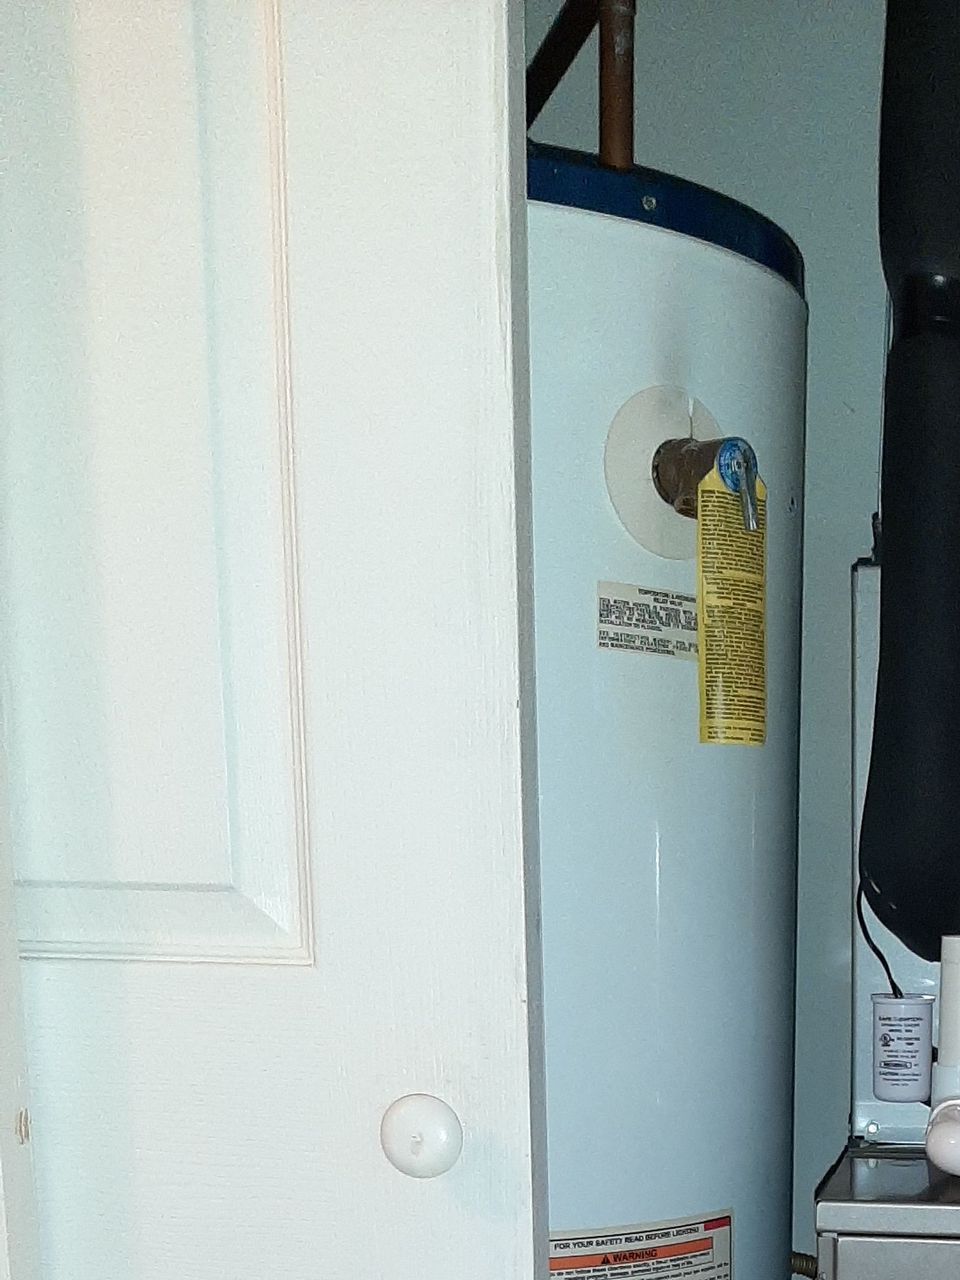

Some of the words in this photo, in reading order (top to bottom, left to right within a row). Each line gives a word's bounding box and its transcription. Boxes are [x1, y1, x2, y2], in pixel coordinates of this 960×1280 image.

[554, 1242, 571, 1250] FOR
[572, 1240, 594, 1249] YOUR
[595, 1237, 622, 1247] SAFETY
[624, 1234, 644, 1244] READ
[645, 1231, 671, 1241] BEFORE
[613, 1249, 658, 1263] WARNING
